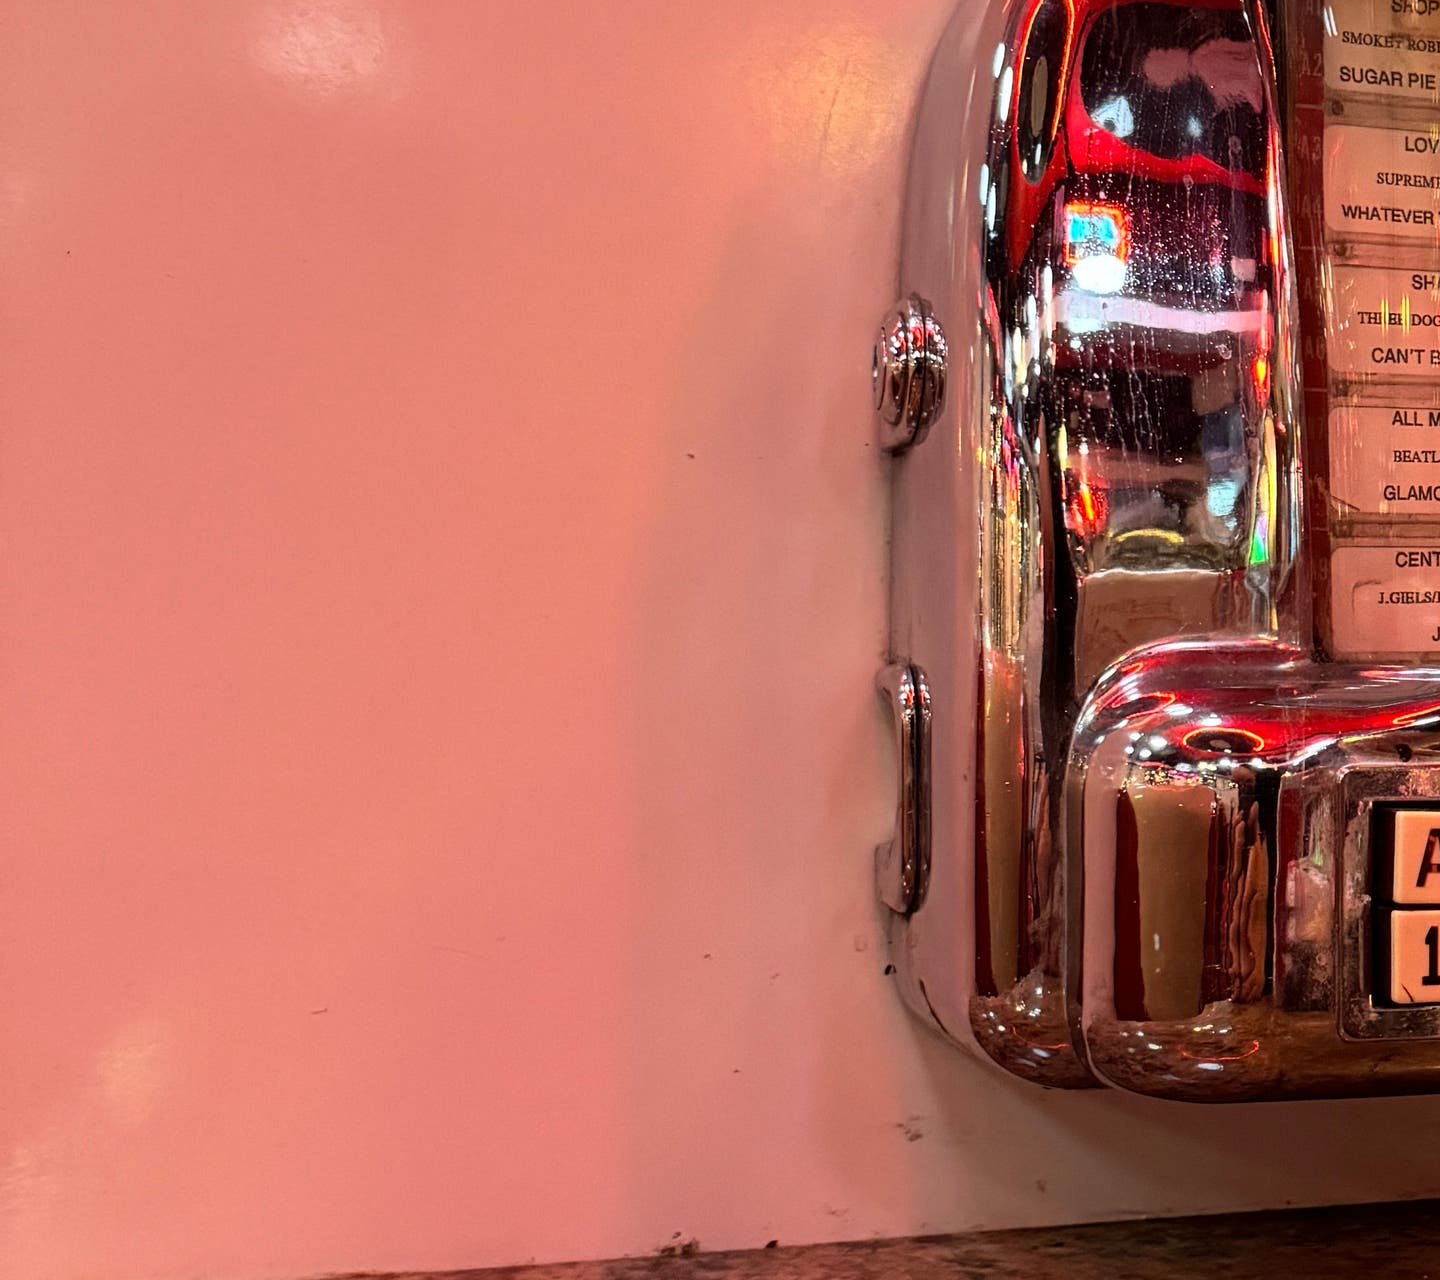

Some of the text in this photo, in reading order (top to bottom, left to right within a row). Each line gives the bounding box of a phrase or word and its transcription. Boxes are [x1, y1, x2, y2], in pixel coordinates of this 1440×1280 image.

[1342, 30, 1403, 48] SMOKEY
[1339, 66, 1403, 88] SUGAR
[1408, 72, 1436, 90] PIE
[1342, 204, 1434, 225] WHATEVER
[1357, 311, 1408, 326] THE
[1371, 347, 1425, 364] CAN'T
[1392, 410, 1423, 427] ALL
